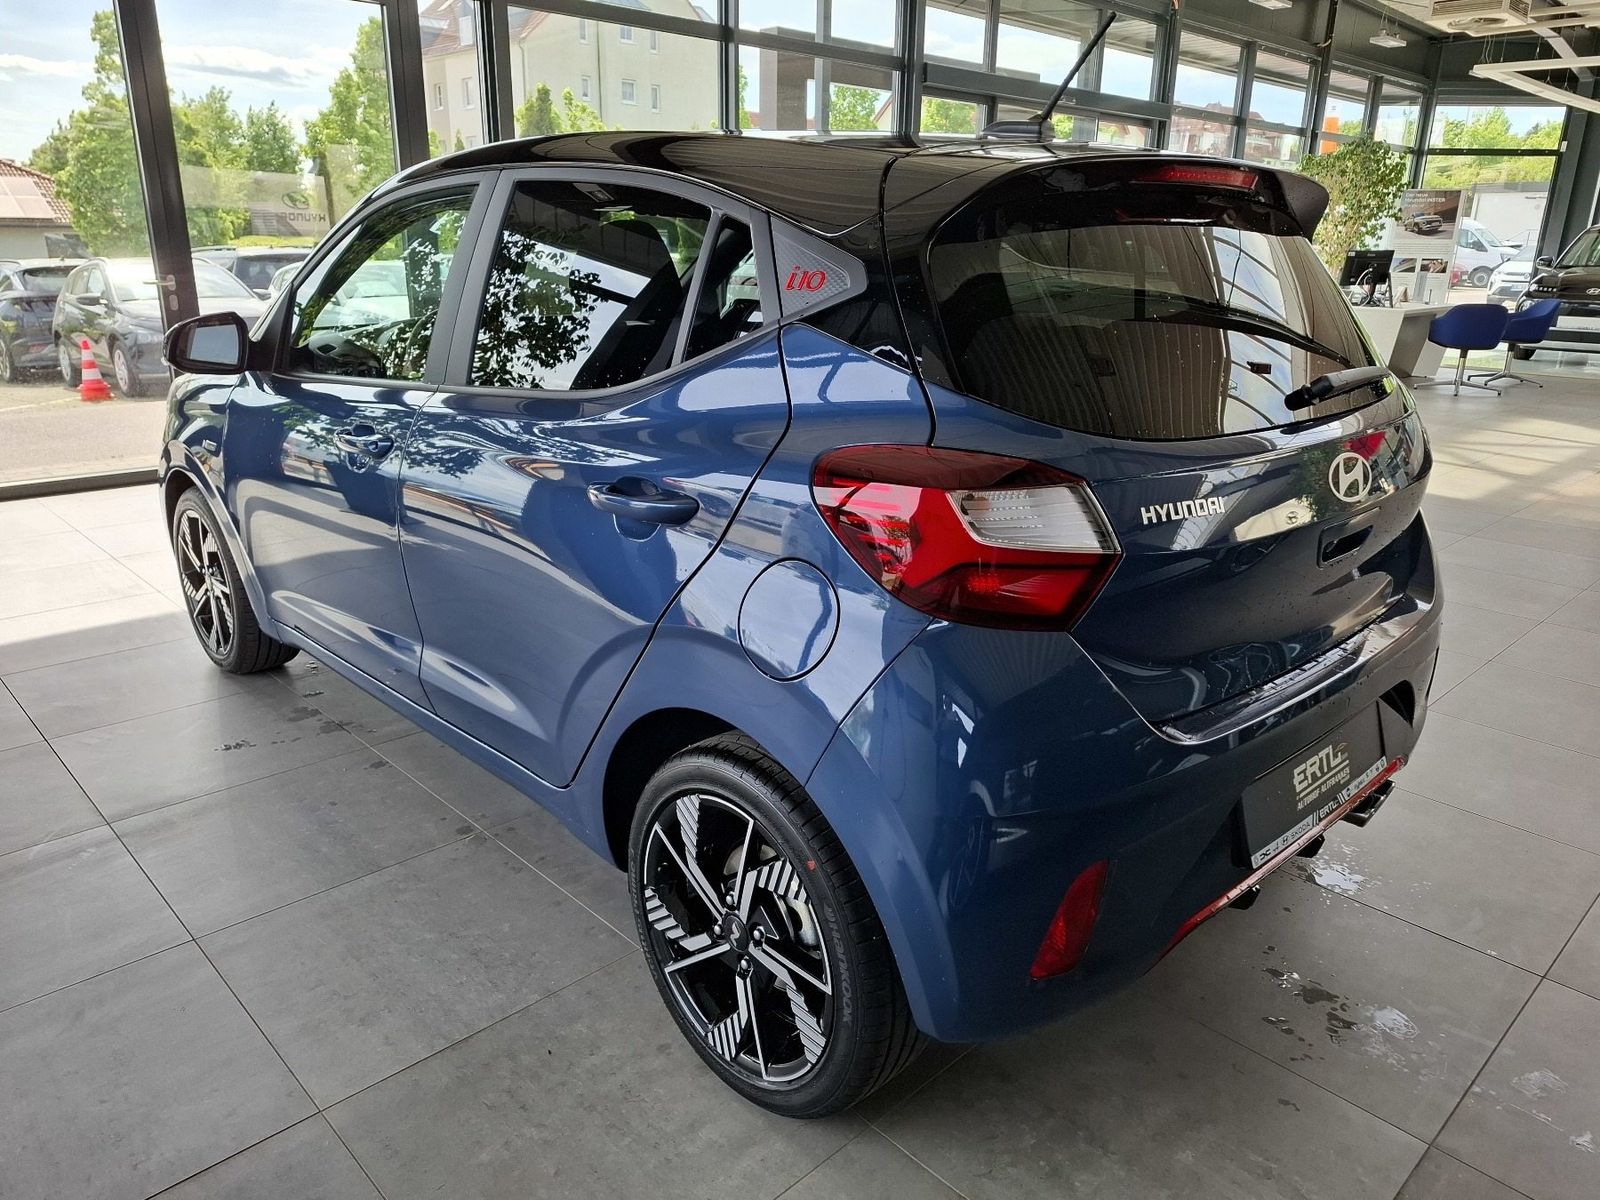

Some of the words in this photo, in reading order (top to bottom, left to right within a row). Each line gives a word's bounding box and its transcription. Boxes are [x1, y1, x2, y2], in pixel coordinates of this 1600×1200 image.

[784, 264, 827, 292] i10
[1140, 496, 1226, 525] HYUNDAI
[1293, 744, 1342, 793] ERTL
